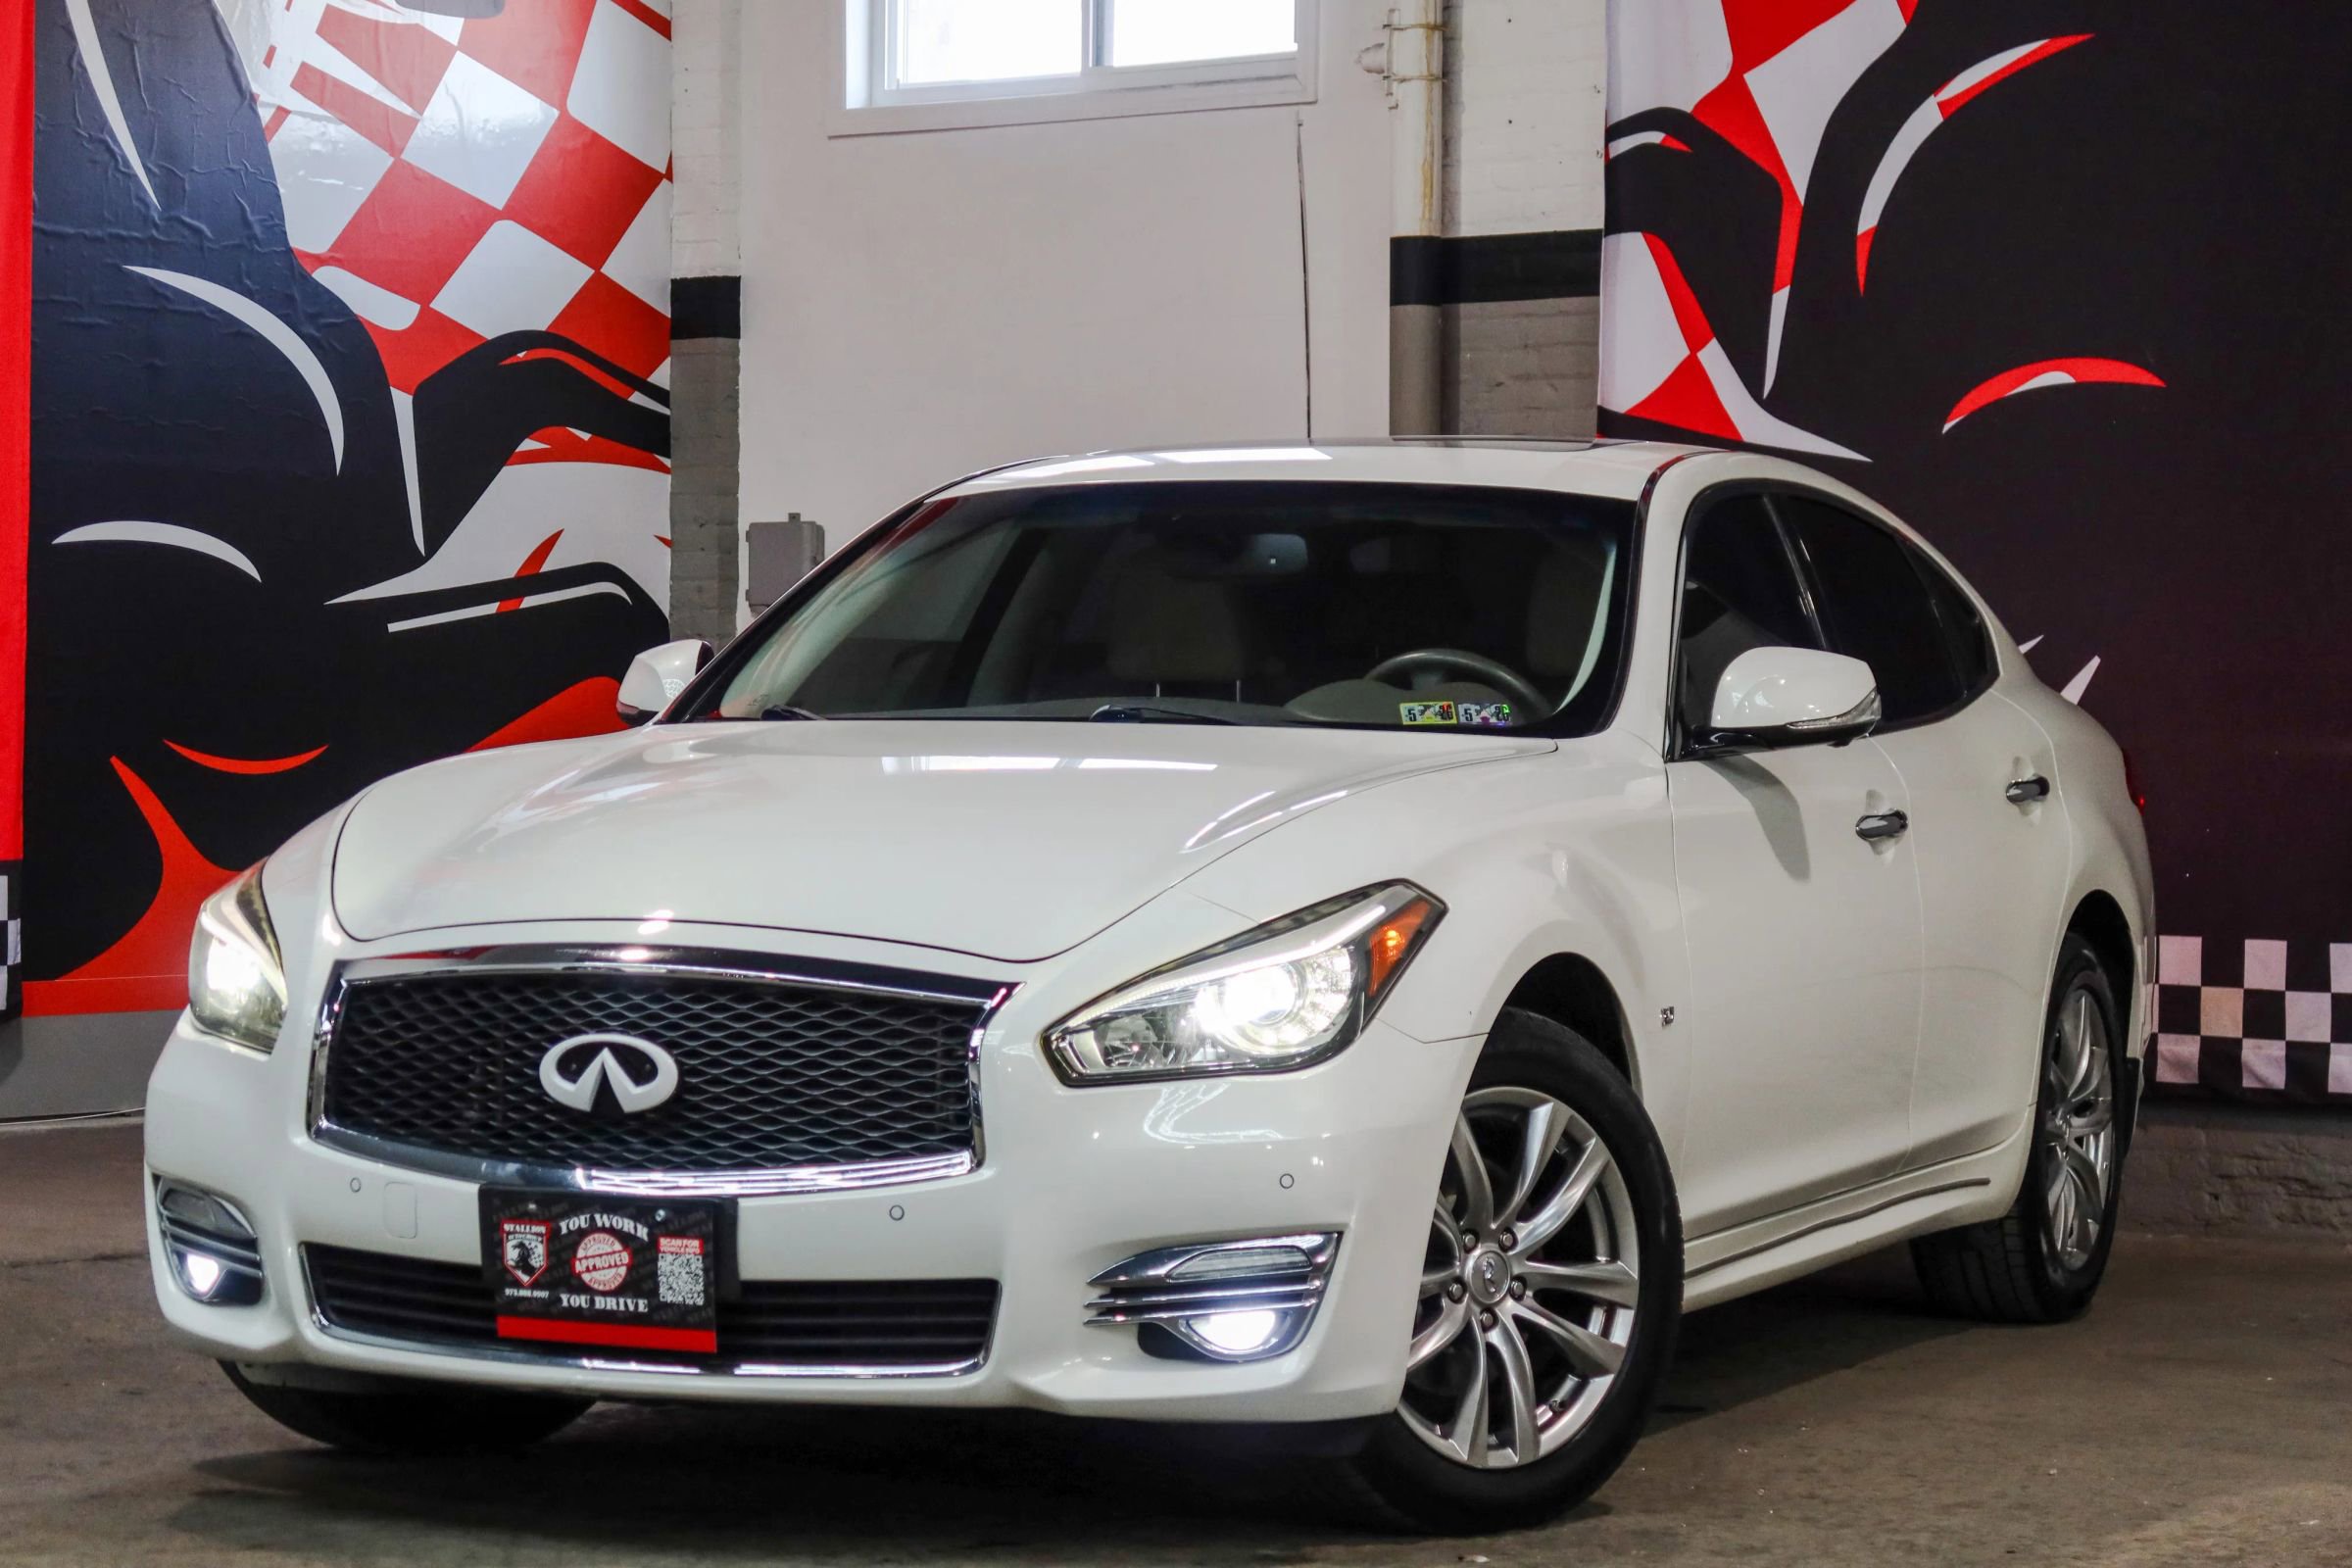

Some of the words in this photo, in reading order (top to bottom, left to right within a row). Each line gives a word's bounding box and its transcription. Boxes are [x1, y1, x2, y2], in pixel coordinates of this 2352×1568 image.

[1408, 709, 1417, 722] 5
[1464, 708, 1473, 722] 5
[559, 1213, 591, 1236] YOU
[594, 1213, 649, 1243] WORK
[575, 1251, 629, 1273] APPROVED
[560, 1293, 591, 1308] YOU
[594, 1296, 649, 1313] DRIVE
